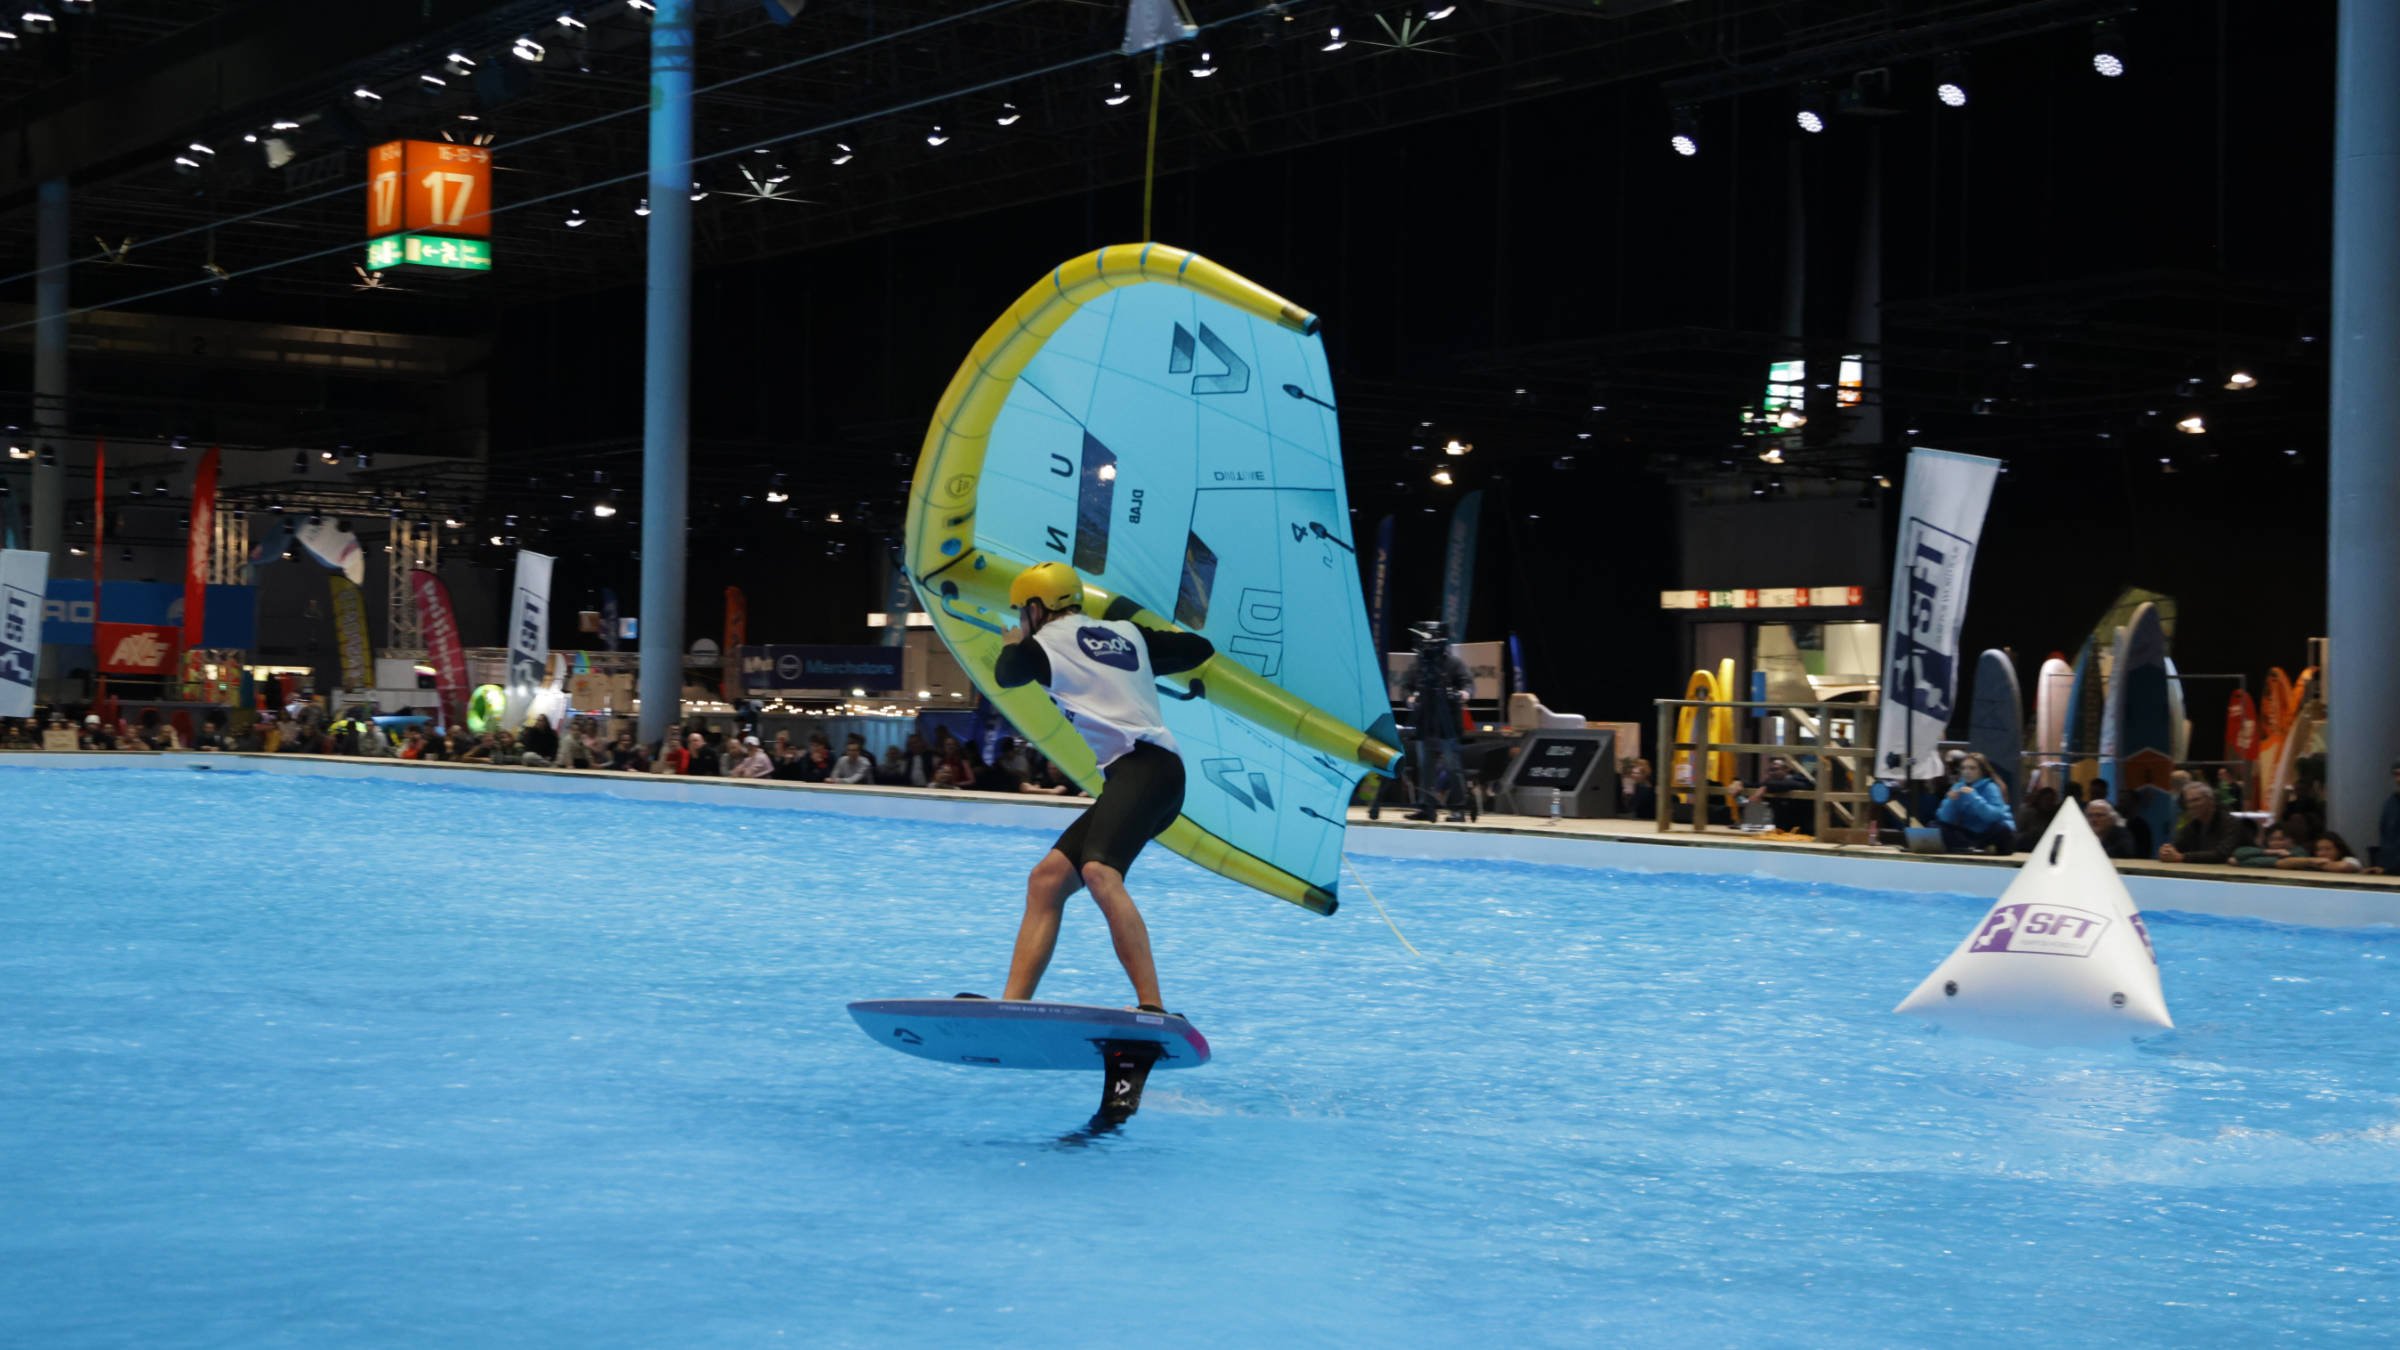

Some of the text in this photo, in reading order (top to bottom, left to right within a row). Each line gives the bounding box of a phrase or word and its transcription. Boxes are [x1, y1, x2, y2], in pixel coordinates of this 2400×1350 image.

[375, 170, 398, 227] 17
[421, 171, 475, 226] 17
[2025, 911, 2102, 939] SFT
